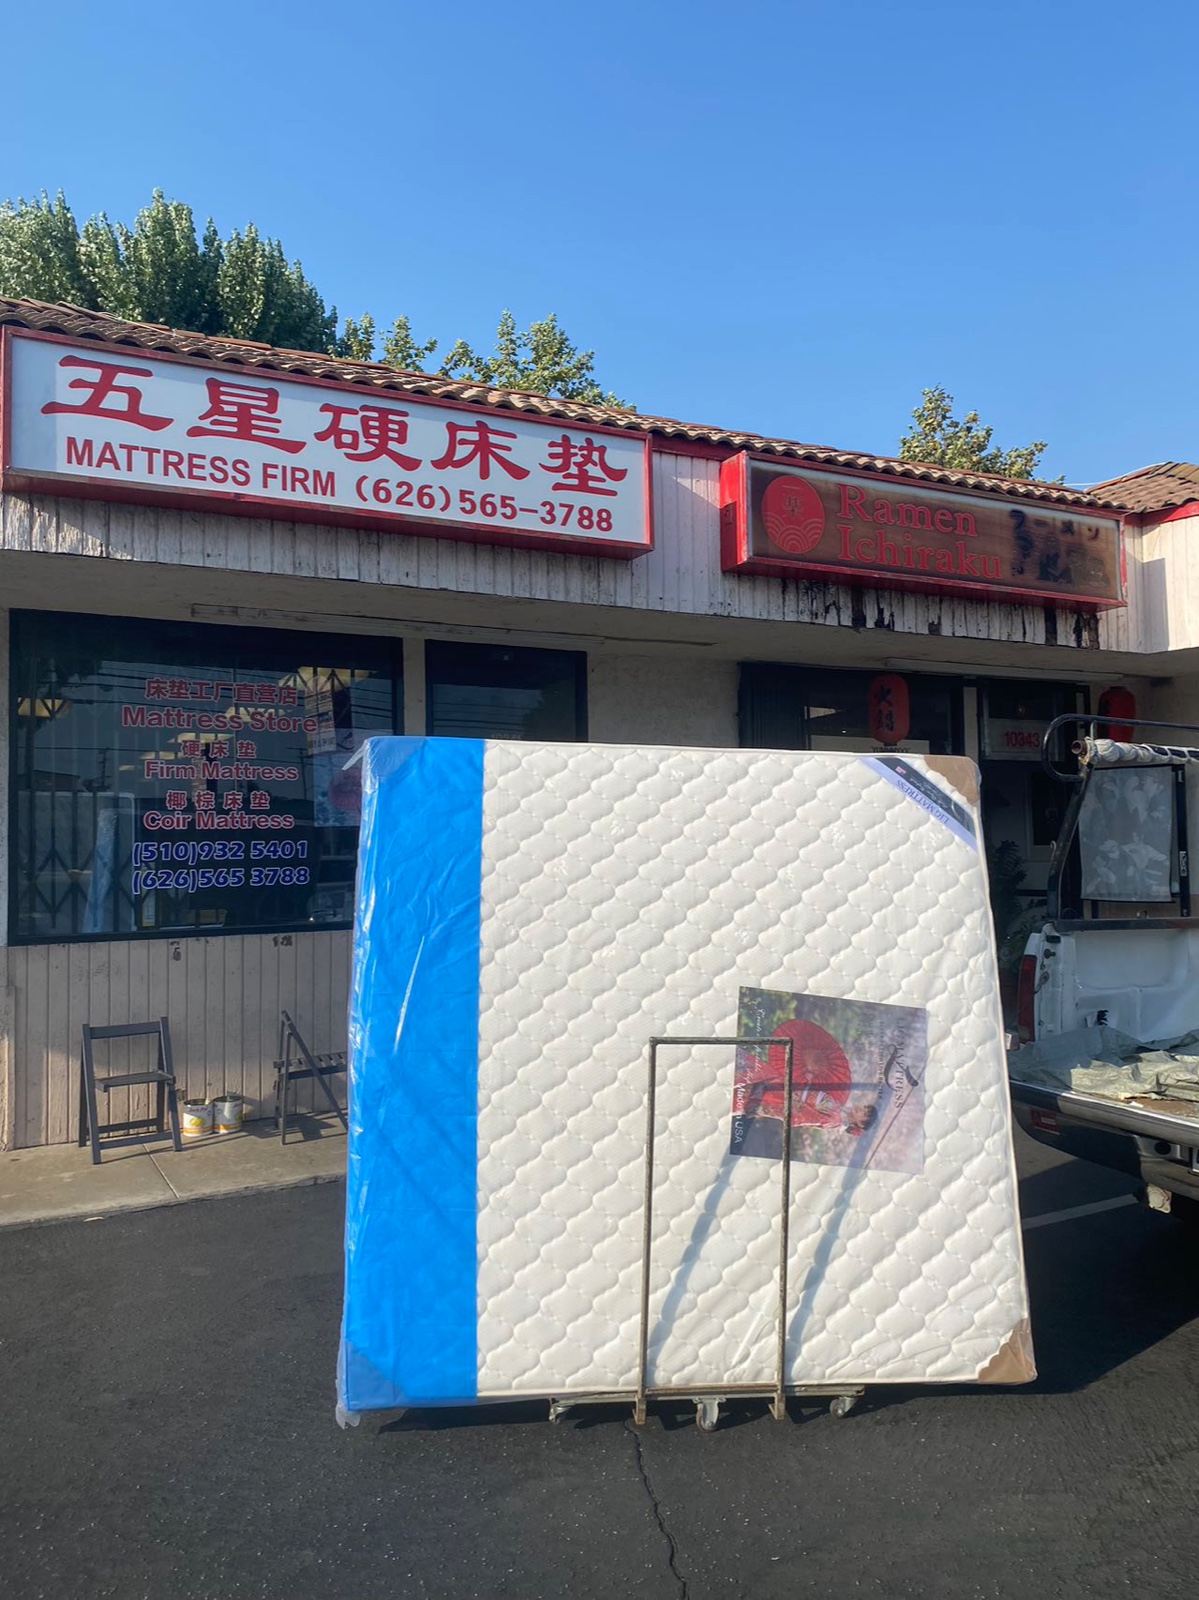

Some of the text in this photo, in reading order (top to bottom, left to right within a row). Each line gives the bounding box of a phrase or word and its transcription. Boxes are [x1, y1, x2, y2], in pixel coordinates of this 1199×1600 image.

[41, 355, 628, 498] 五星硬床垫
[66, 436, 252, 487] MATTRESS
[262, 462, 337, 498] FIRM
[836, 483, 978, 538] Ramen
[838, 526, 1004, 581] Ichiraku
[145, 678, 298, 705] 床垫工厂直营店
[121, 705, 319, 733] Mattress Store
[144, 761, 299, 780] Firm Mattress
[896, 779, 936, 814] MATTRESS
[143, 811, 295, 830] Coir Mattress
[133, 840, 309, 866] (510)932 5401
[133, 867, 311, 894] (626)565 3788
[735, 1082, 747, 1109] Made
[733, 1121, 743, 1144] USA
